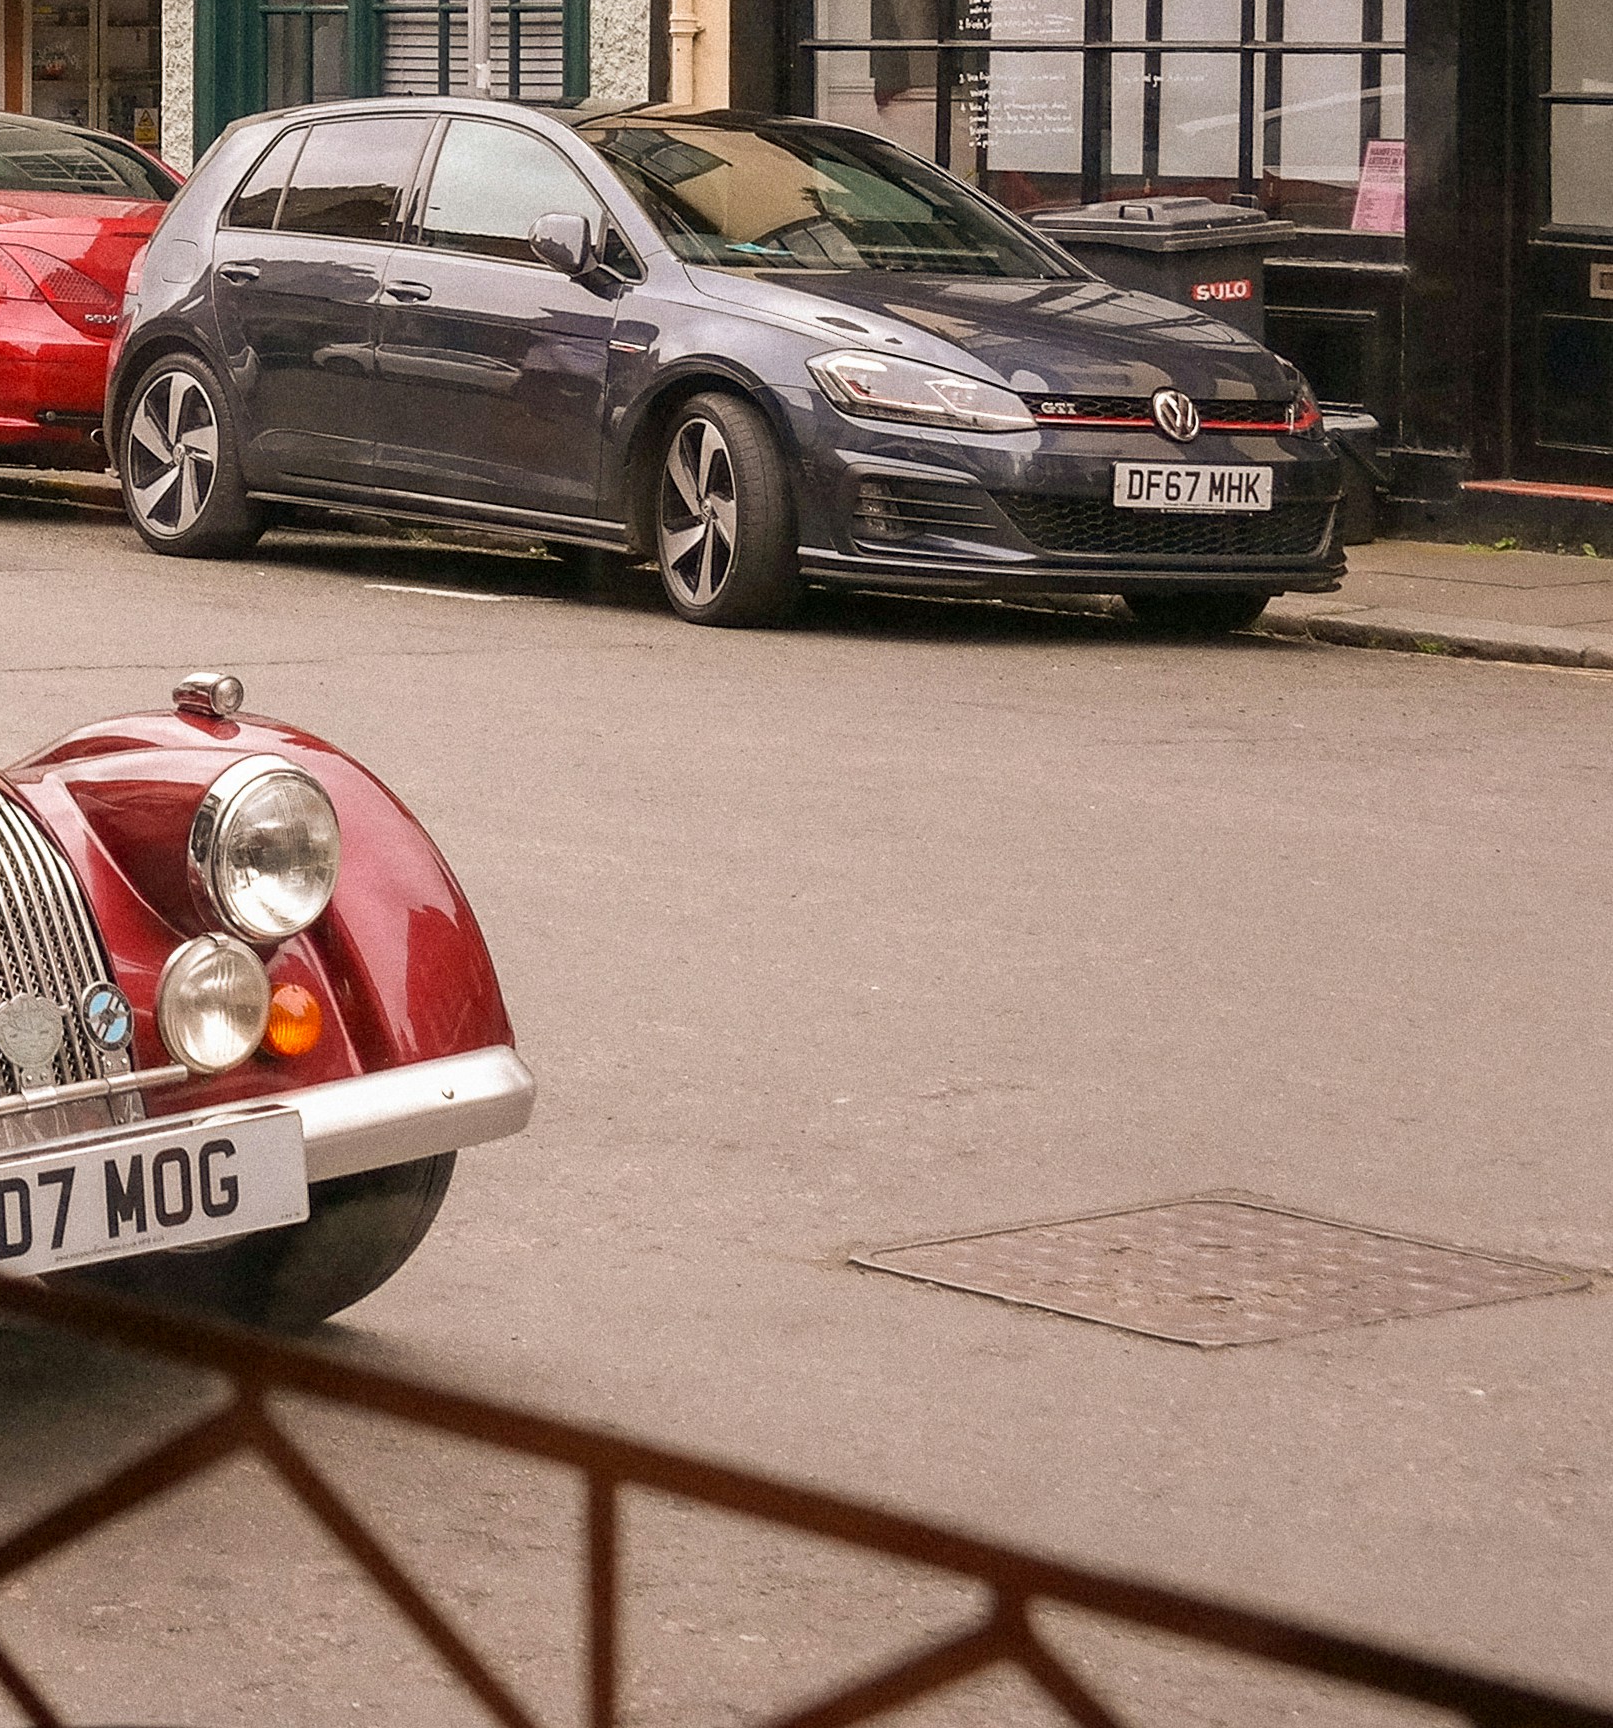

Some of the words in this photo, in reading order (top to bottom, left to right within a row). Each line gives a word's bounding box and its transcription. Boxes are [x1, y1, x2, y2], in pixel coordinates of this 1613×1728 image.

[1196, 281, 1248, 301] SULO
[1041, 401, 1077, 415] GTI
[1127, 469, 1201, 502] DF67
[1209, 471, 1261, 504] MHK
[104, 1138, 240, 1239] MOG
